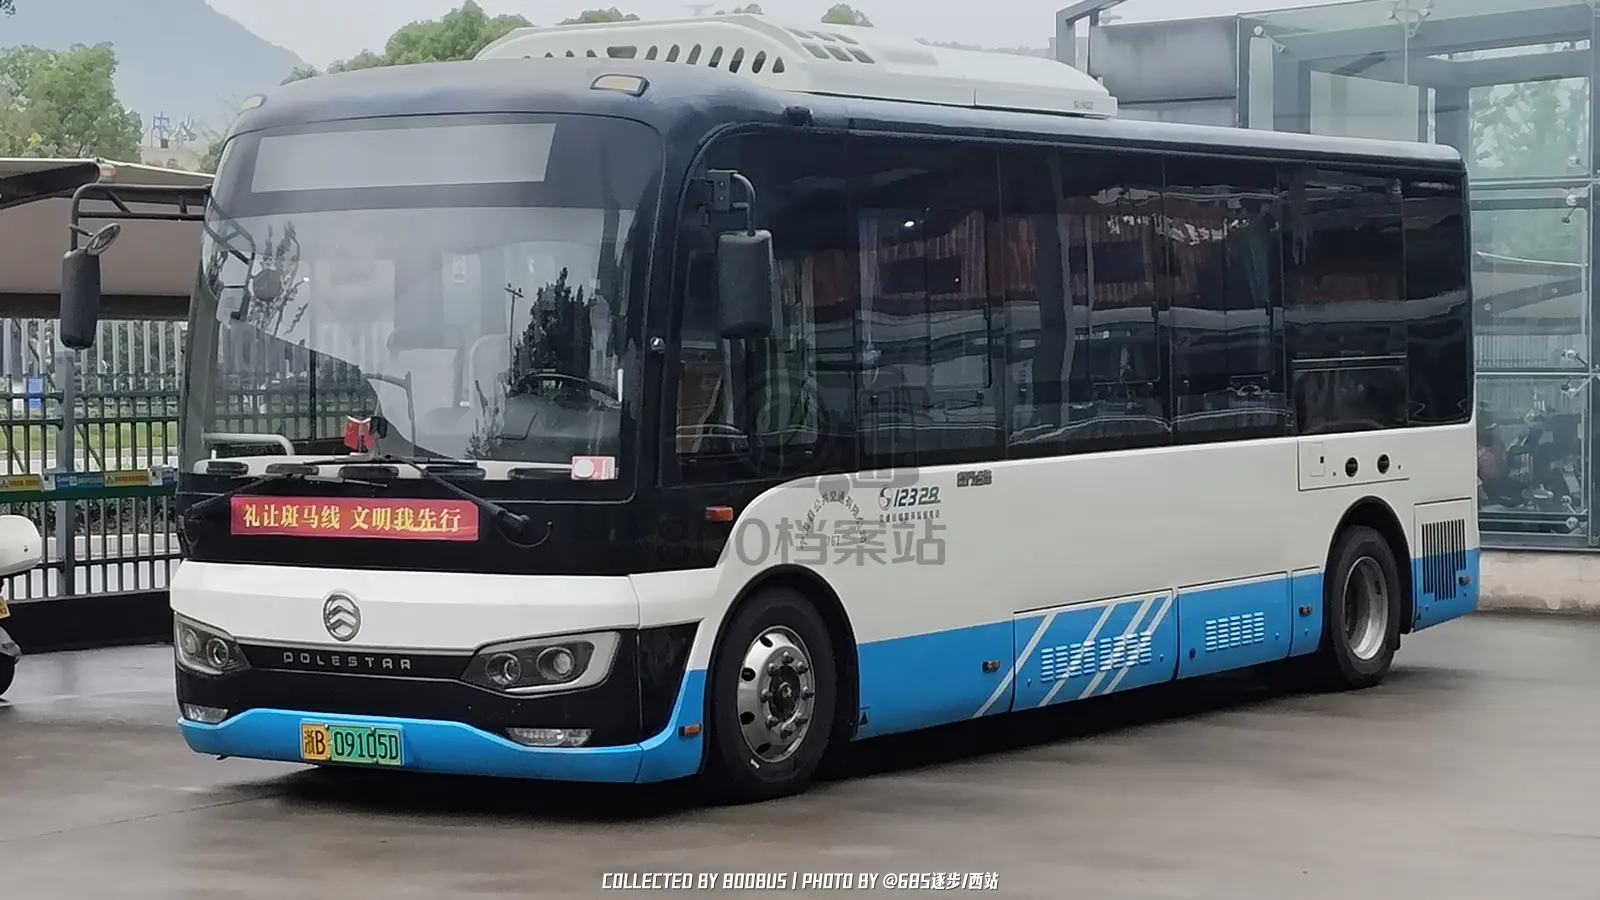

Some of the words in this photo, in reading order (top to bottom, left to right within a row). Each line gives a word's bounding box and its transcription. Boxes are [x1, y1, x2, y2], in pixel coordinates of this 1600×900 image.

[893, 486, 939, 507] 12328
[243, 504, 341, 529] 礼让斑马线
[350, 505, 462, 532] 文明我先行
[283, 652, 411, 670] POLESTAR
